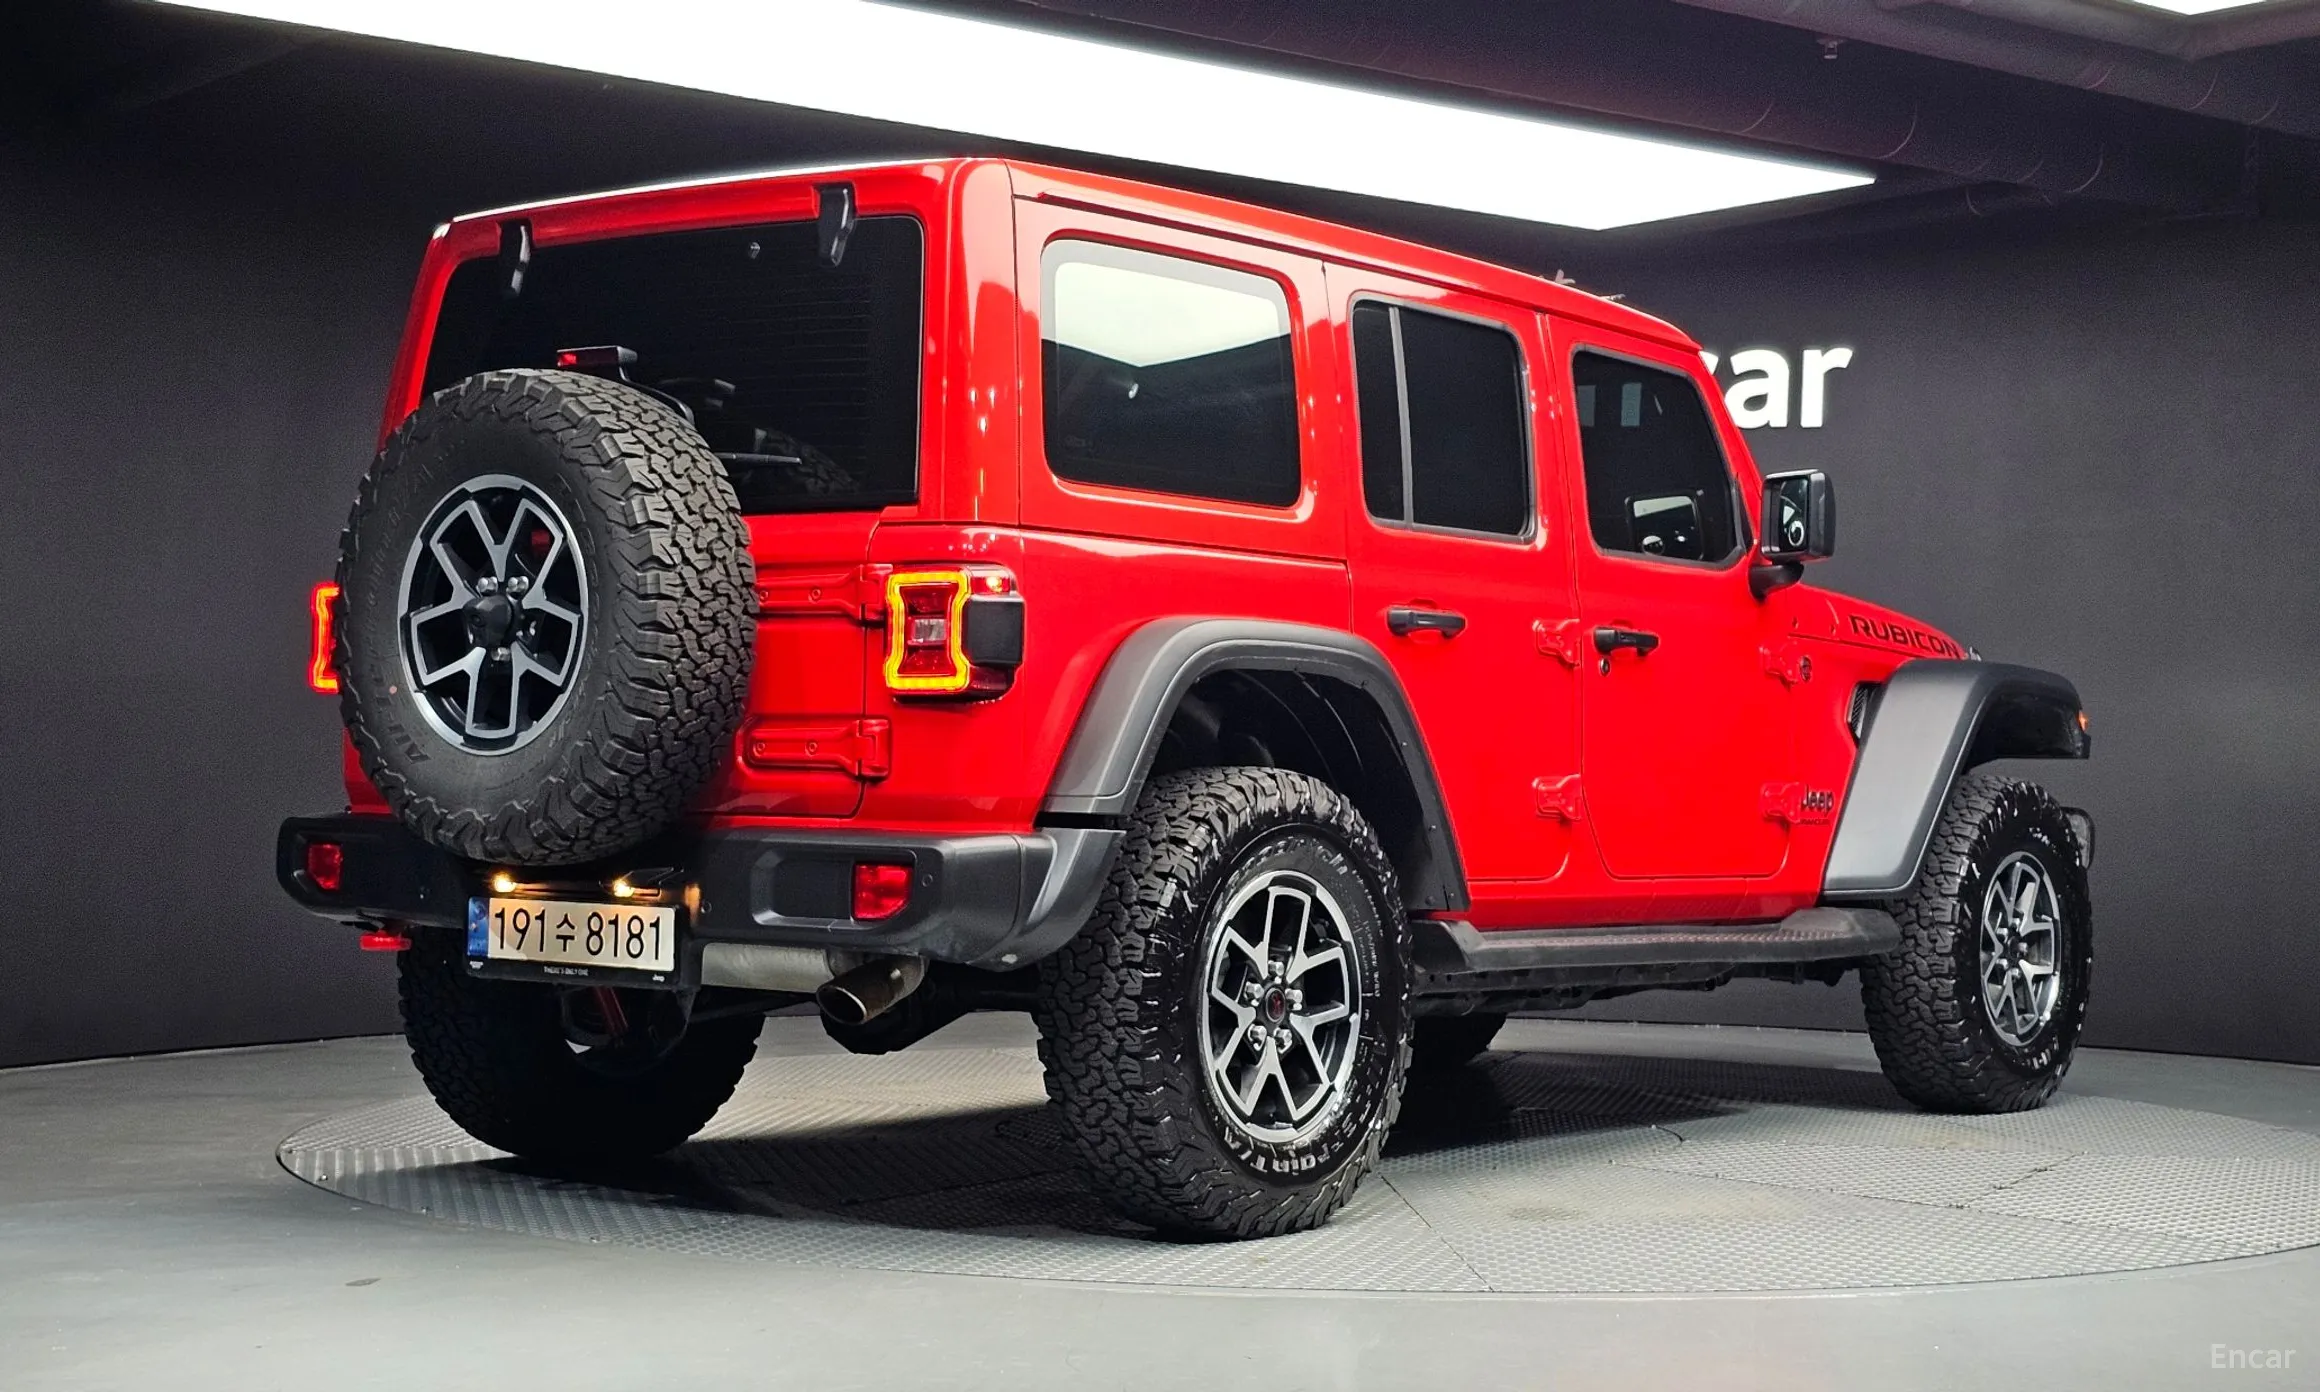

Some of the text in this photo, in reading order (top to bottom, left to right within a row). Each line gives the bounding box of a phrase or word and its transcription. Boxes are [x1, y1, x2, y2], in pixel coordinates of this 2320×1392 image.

[1698, 347, 1853, 429] ar
[1850, 615, 1959, 659] RUBICON
[1801, 784, 1834, 817] Jeep
[494, 907, 661, 960] 191수8181
